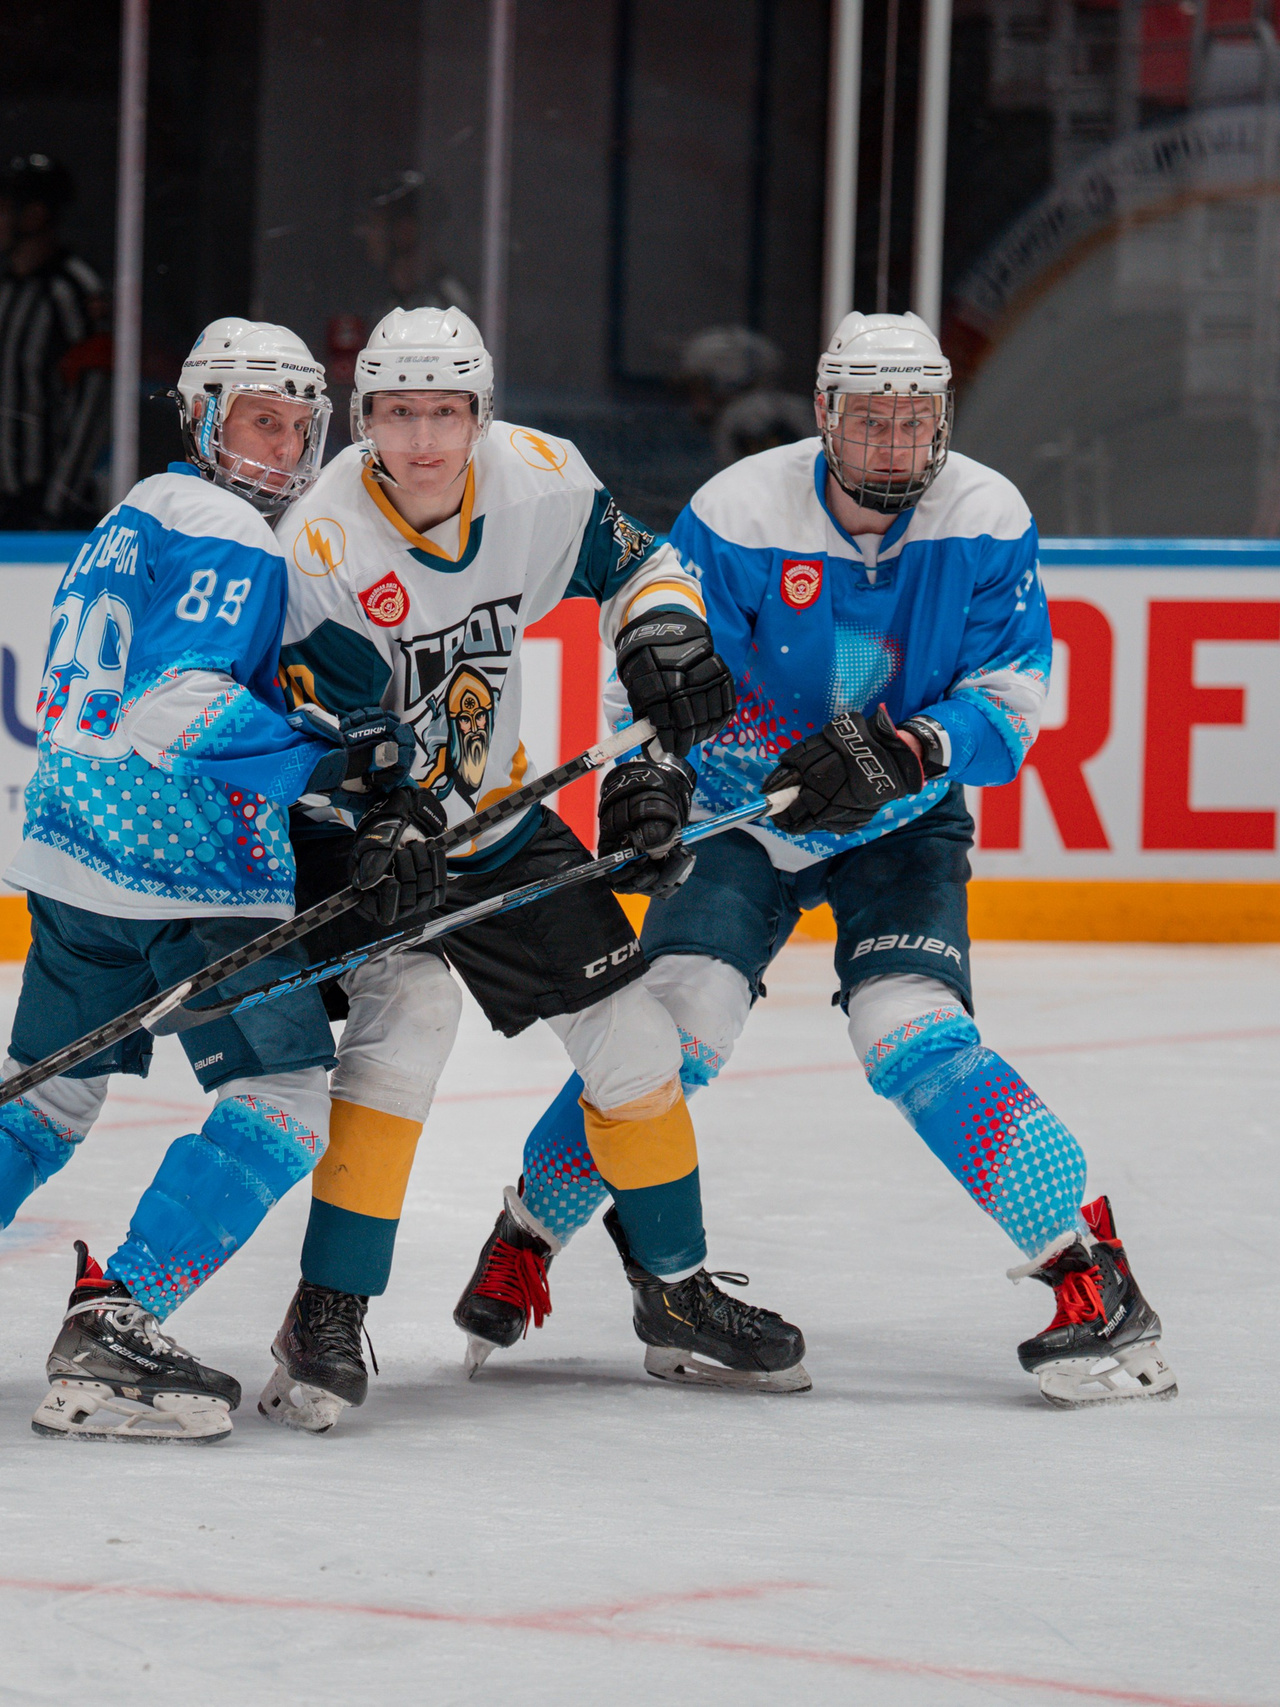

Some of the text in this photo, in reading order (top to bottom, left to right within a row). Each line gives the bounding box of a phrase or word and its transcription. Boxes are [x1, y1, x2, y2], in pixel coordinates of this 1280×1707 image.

[281, 362, 316, 374] BAUER
[201, 397, 217, 457] BAUER
[348, 726, 387, 739] VITOKIN
[831, 712, 896, 795] BAUER
[582, 938, 641, 980] CCM
[848, 934, 963, 971] BAUER
[231, 954, 368, 1014] BAUER
[194, 1052, 224, 1071] BAUER
[1103, 1304, 1128, 1337] BAUER
[109, 1343, 159, 1371] BAUER
